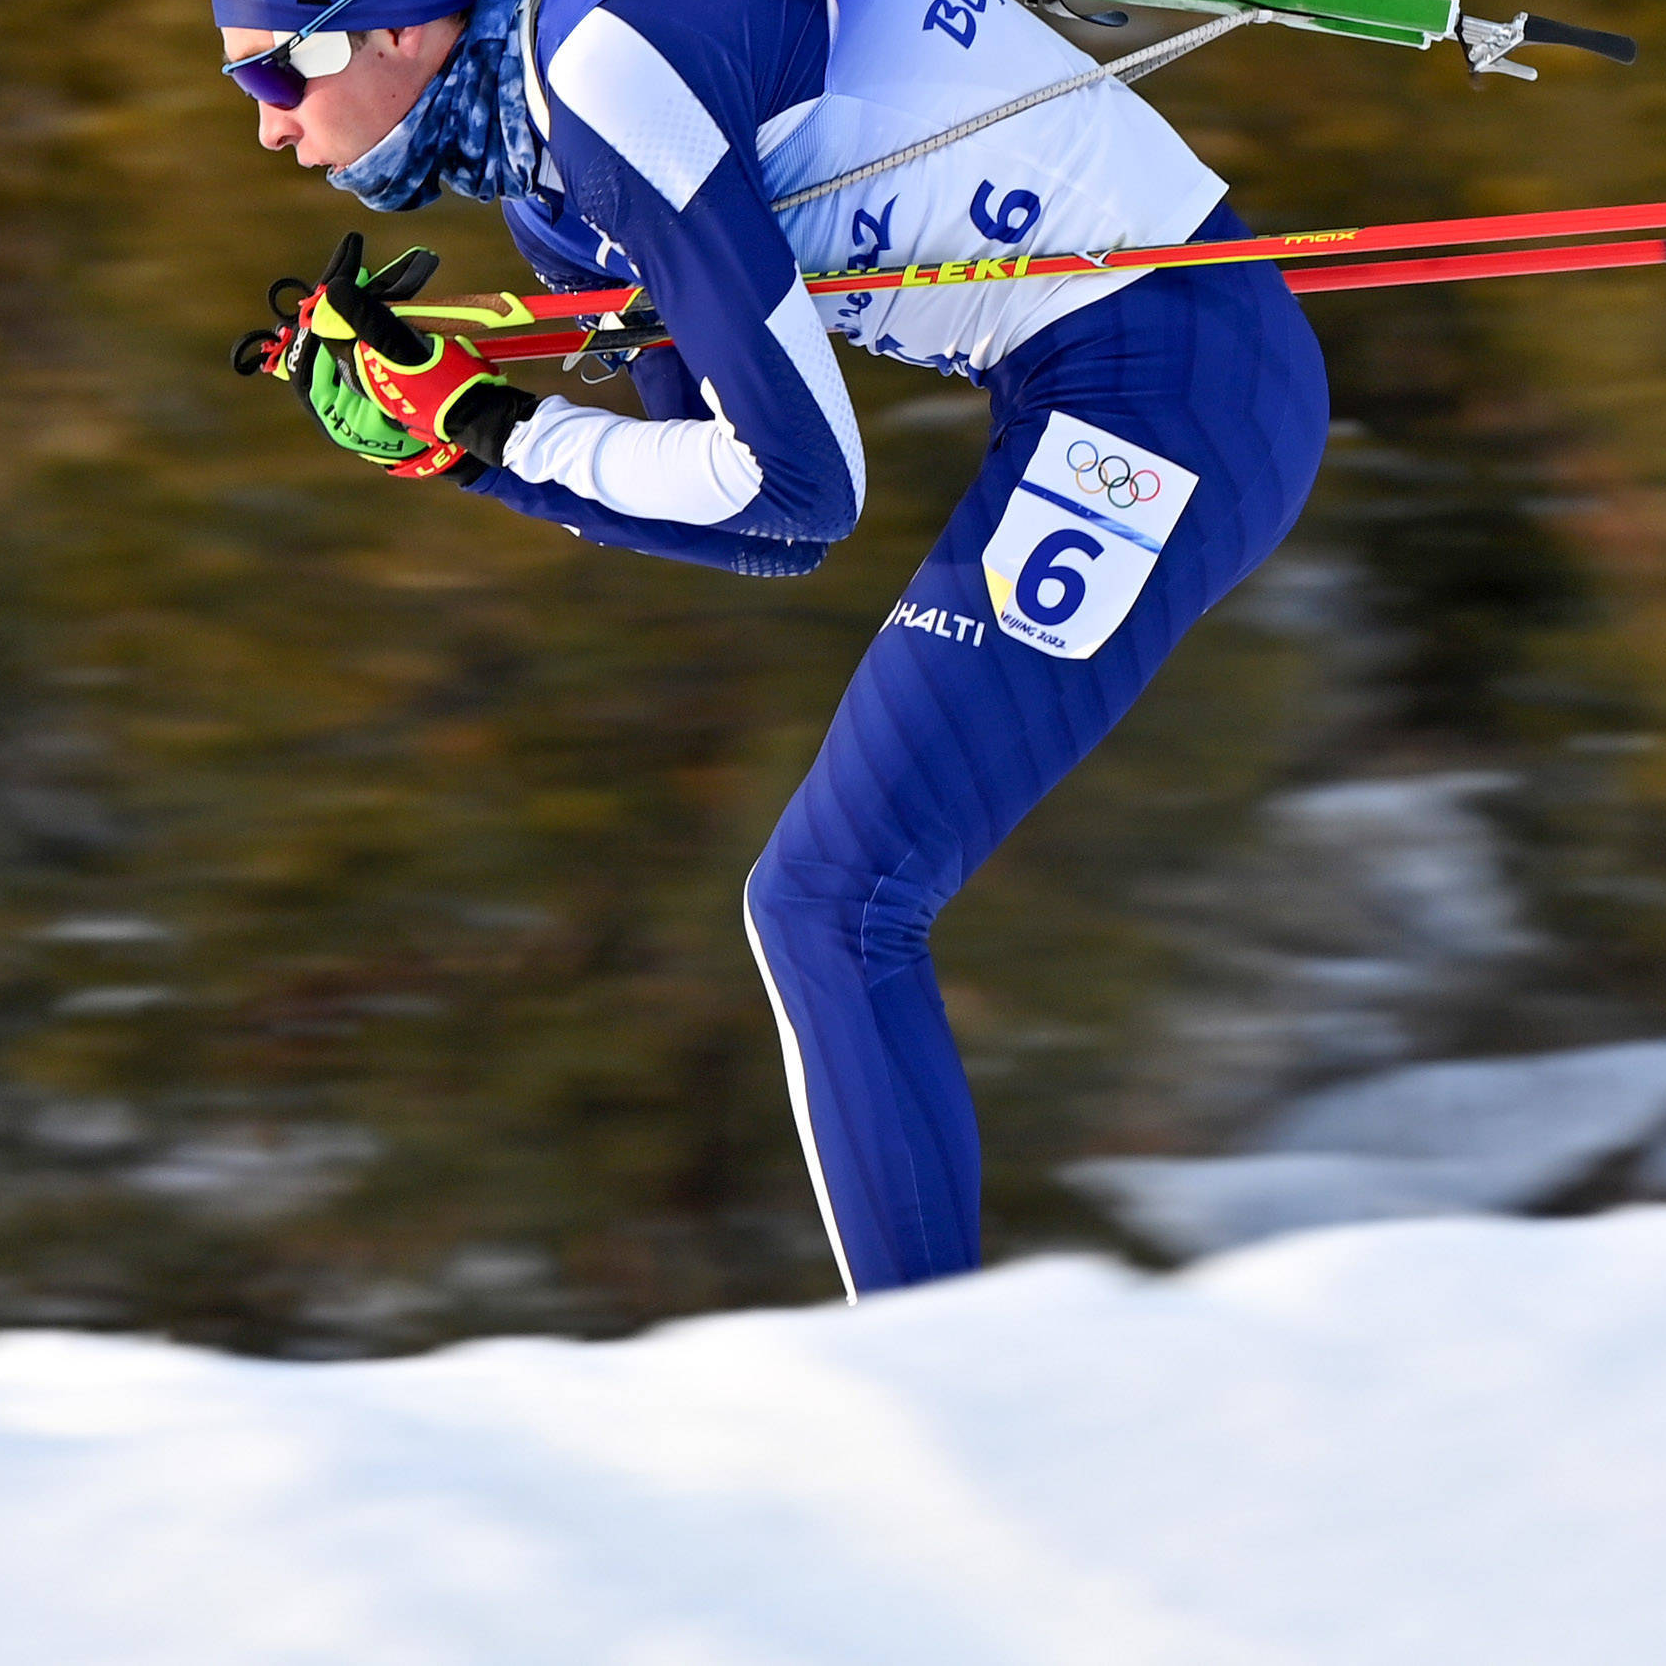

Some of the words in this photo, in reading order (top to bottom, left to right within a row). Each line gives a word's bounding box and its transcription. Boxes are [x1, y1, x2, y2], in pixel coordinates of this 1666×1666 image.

[969, 179, 1041, 245] 6
[901, 255, 1031, 287] LEKI
[363, 347, 417, 414] LEKI
[1015, 528, 1105, 627] 6
[894, 602, 985, 647] HALTI
[1037, 630, 1068, 650] 2022
